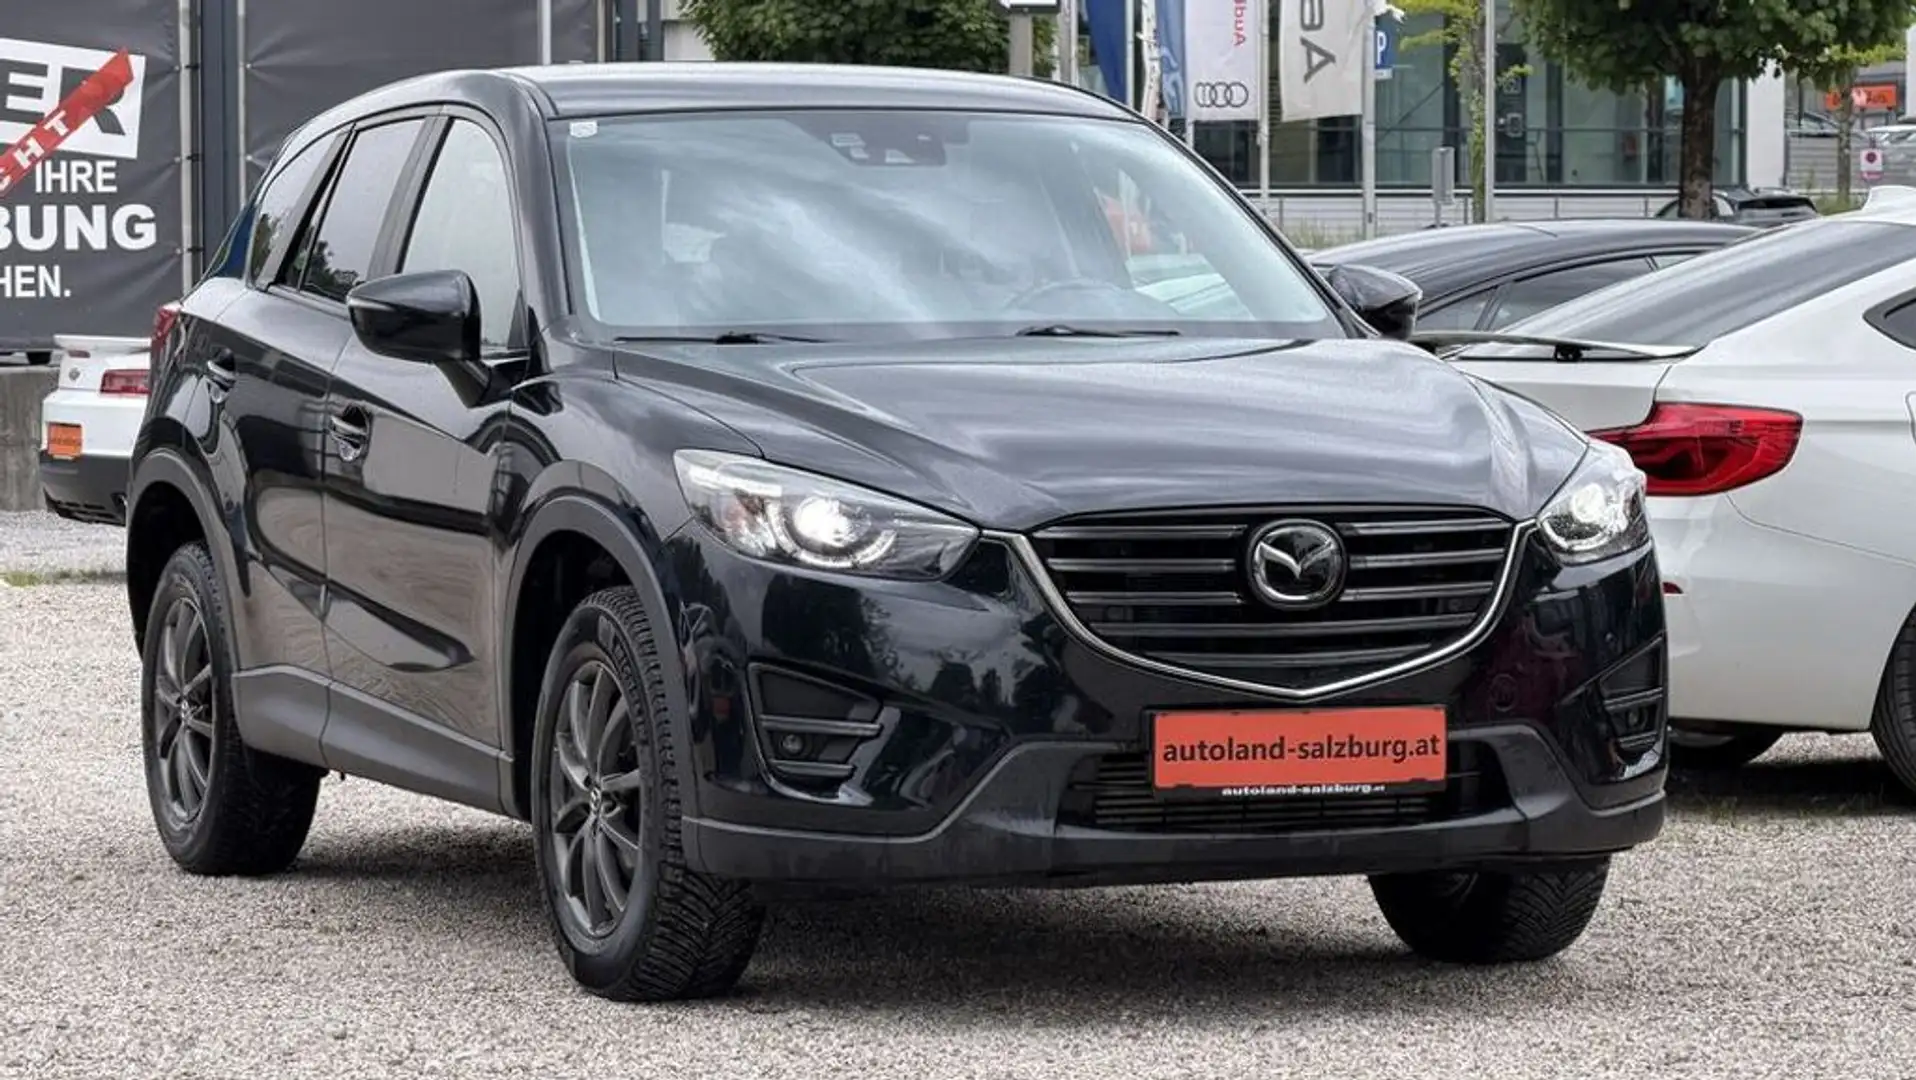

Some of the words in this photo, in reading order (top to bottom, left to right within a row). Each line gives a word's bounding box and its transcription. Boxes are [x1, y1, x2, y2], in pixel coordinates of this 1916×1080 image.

[1376, 30, 1388, 65] P
[35, 160, 118, 193] IHRE
[1163, 735, 1440, 763] autoland-salzburg.at
[1221, 785, 1386, 796] autoland-salzburg.at
